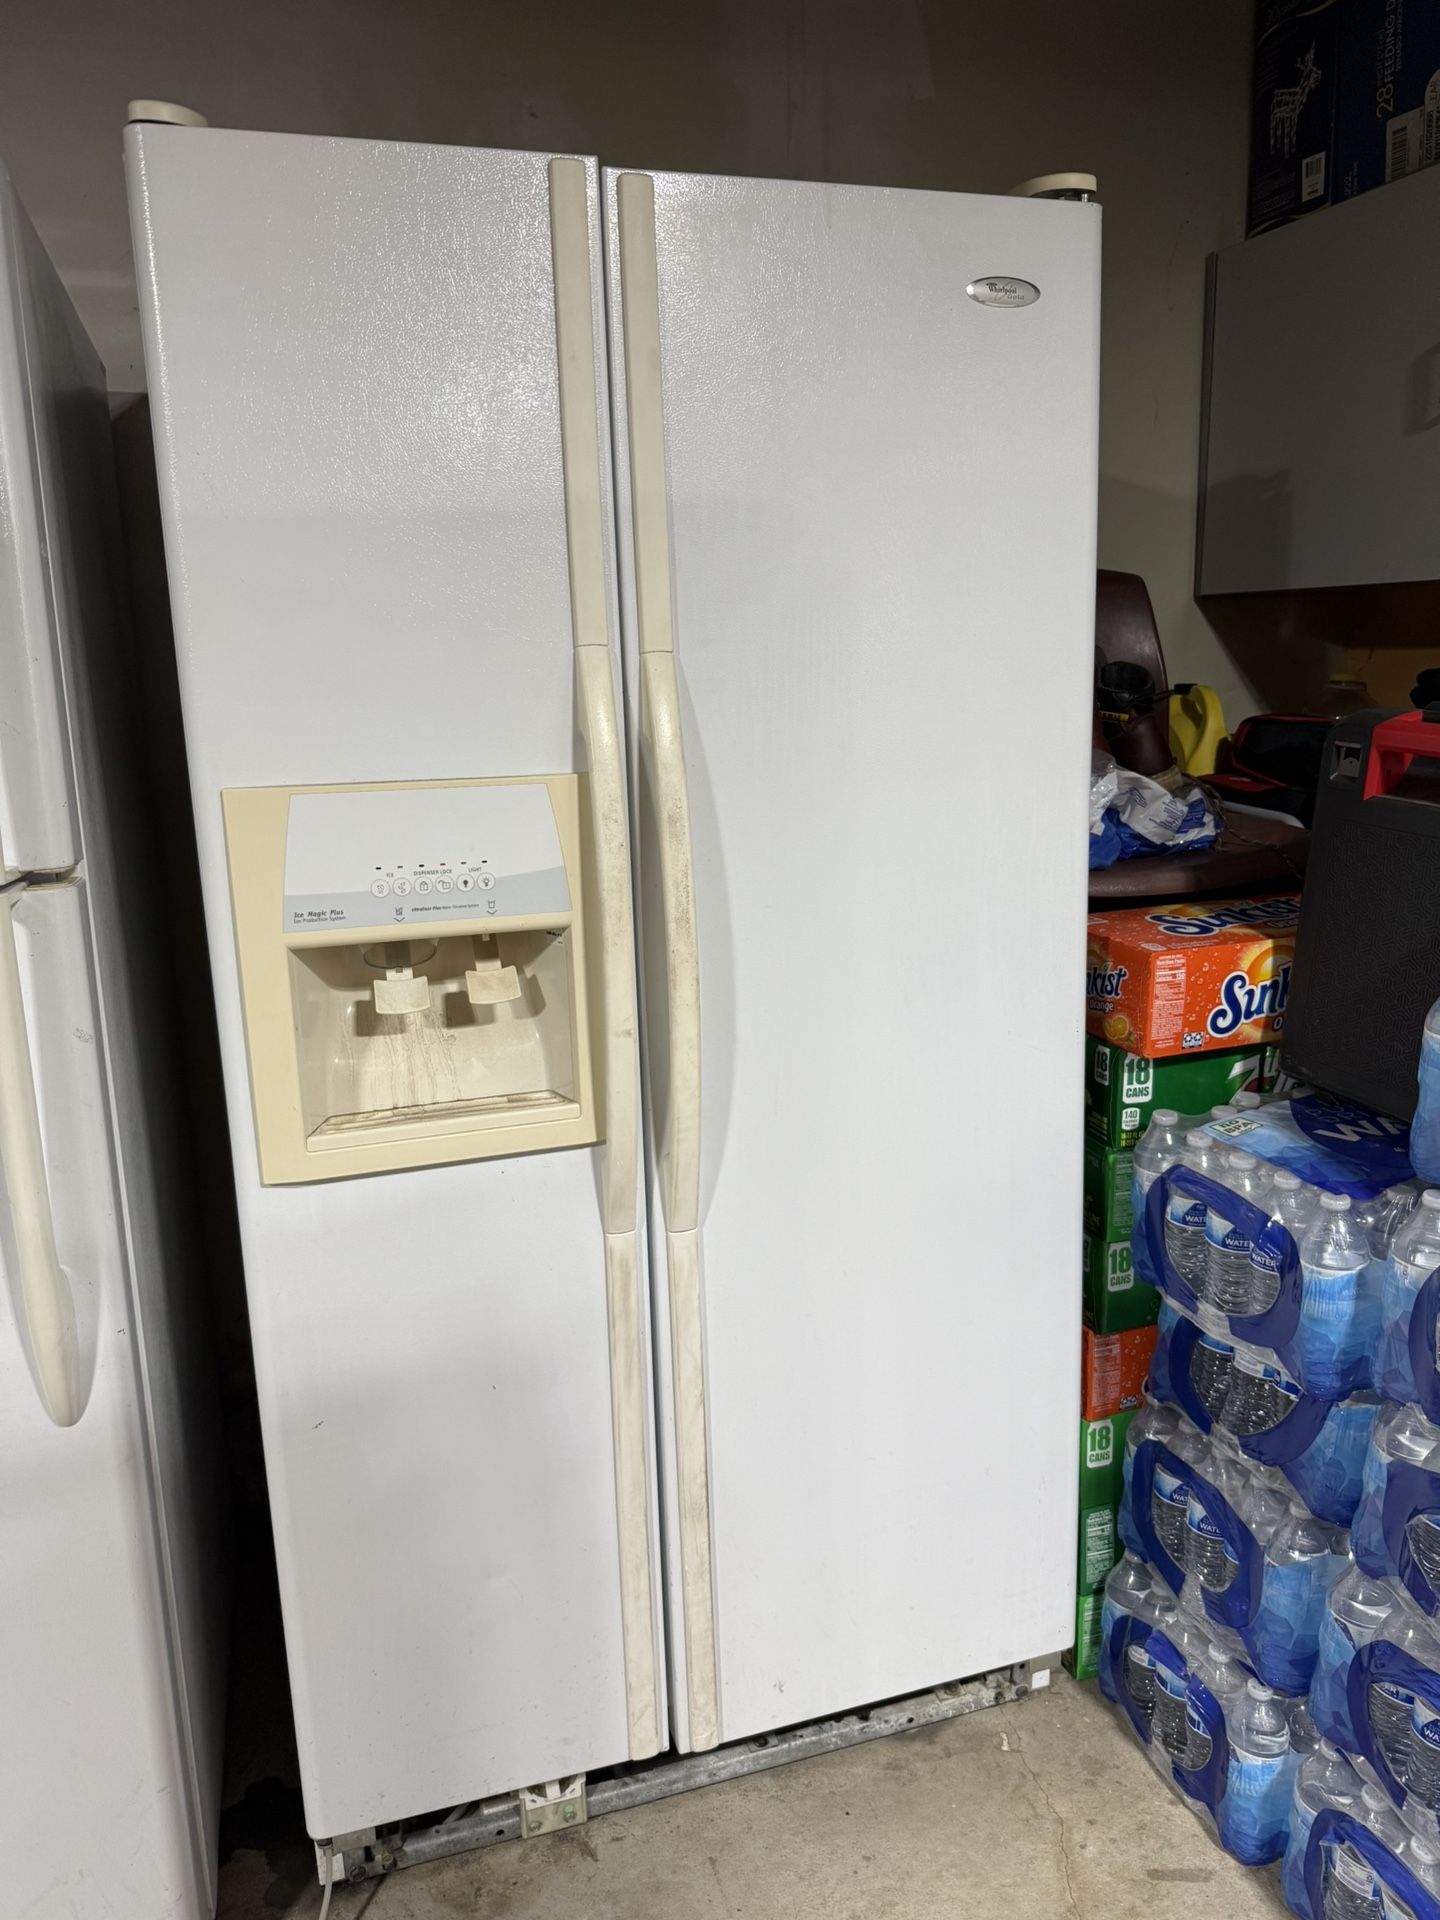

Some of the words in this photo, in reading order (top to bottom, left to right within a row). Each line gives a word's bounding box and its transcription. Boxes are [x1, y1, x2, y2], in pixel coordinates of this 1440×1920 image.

[1384, 15, 1396, 83] FEEDING
[1376, 83, 1394, 118] 28
[987, 283, 1017, 294] Whirlpool
[307, 910, 327, 918] Magic
[1096, 1051, 1108, 1072] 18
[1126, 1059, 1150, 1085] 18
[1126, 1087, 1149, 1098] CANS
[1124, 1110, 1138, 1119] 140
[1219, 1120, 1239, 1128] no
[1224, 1122, 1251, 1133] BPA
[1224, 1237, 1249, 1247] WATE
[1110, 1247, 1132, 1275] 18
[1110, 1274, 1131, 1287] CANS
[1089, 1426, 1111, 1452] 18
[1089, 1450, 1110, 1463] CANS
